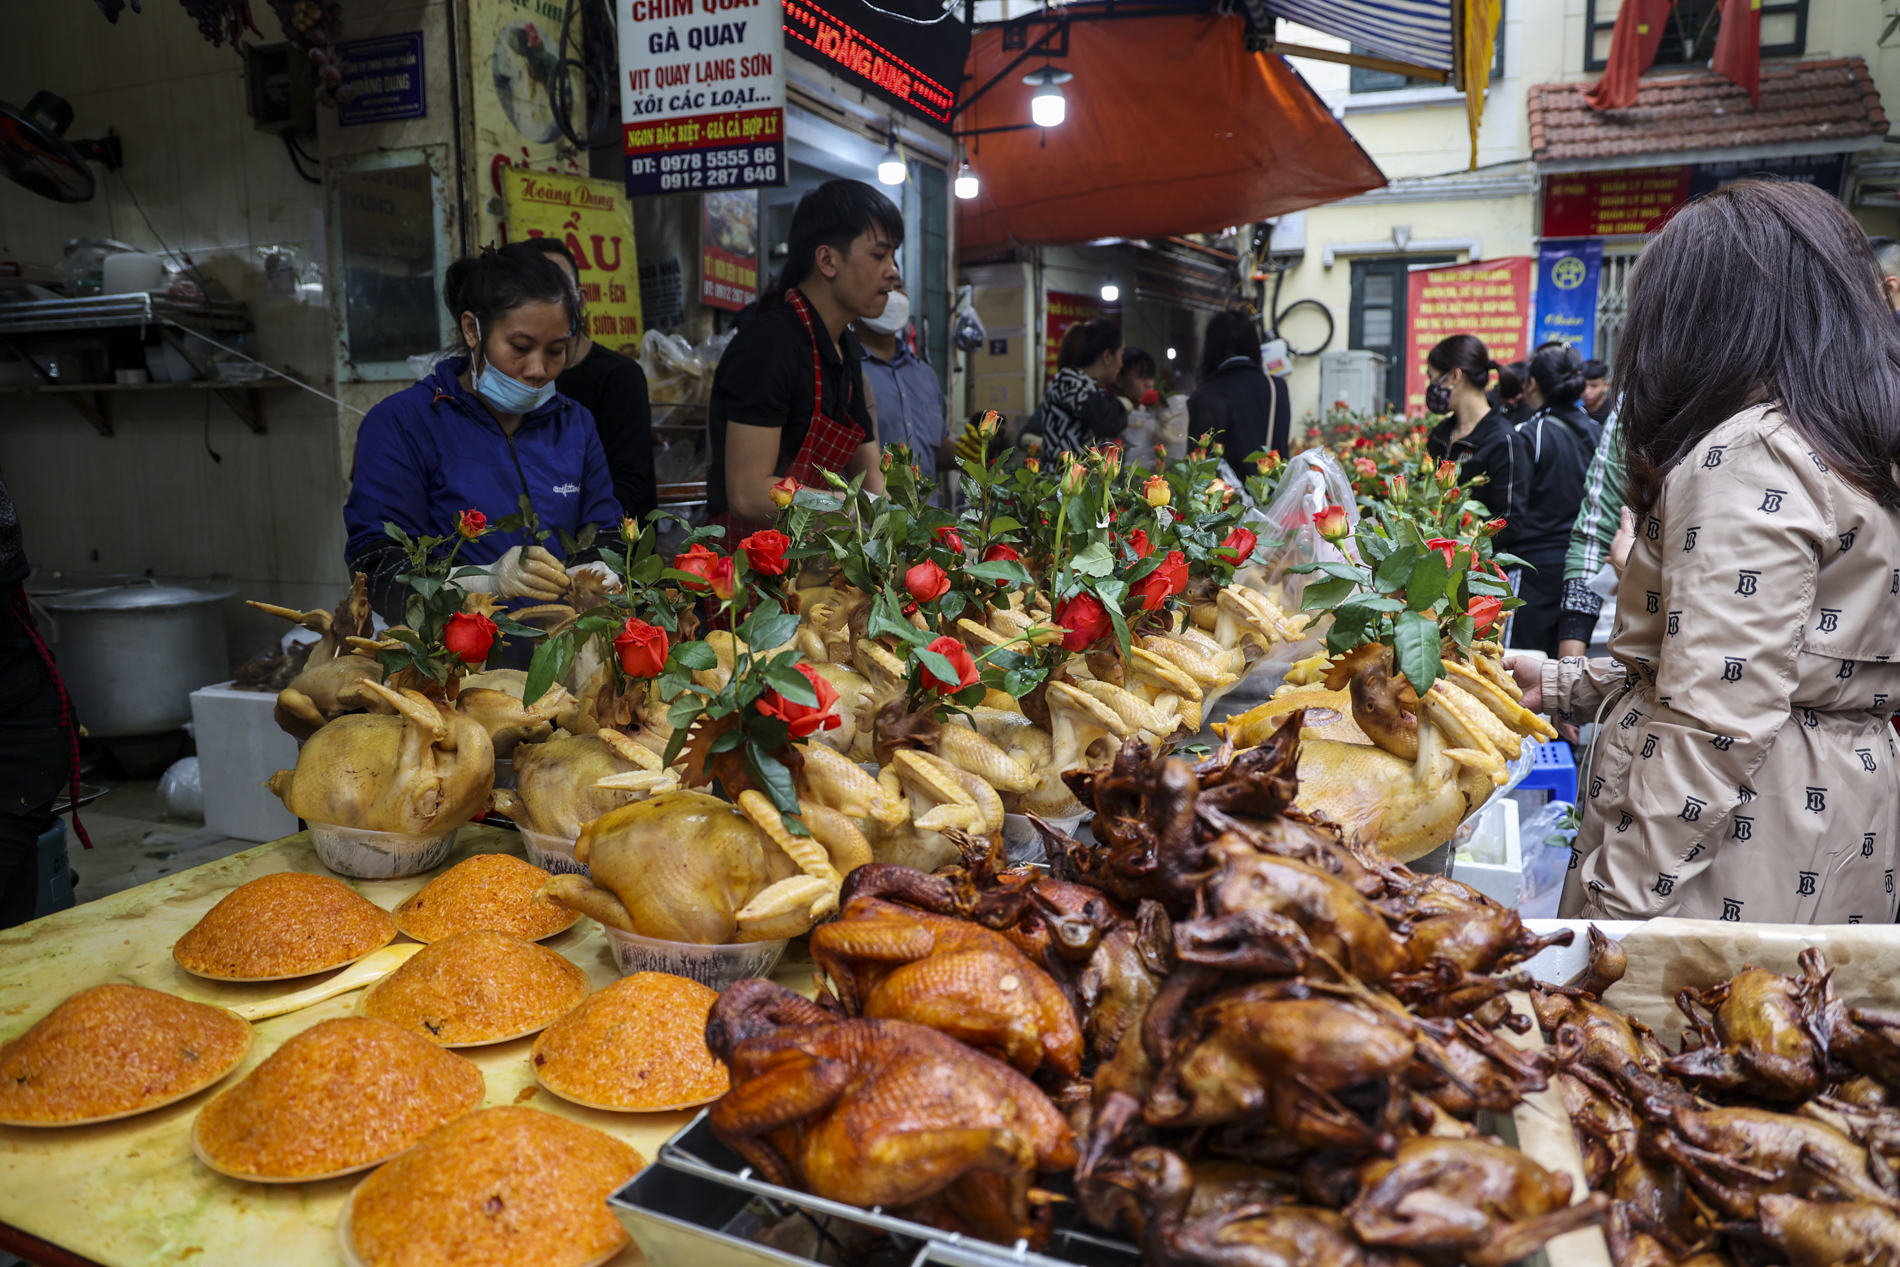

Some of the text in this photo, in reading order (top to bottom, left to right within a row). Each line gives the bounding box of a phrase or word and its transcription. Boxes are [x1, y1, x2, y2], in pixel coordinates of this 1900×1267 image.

[632, 0, 761, 22] CHIM QU
[649, 21, 747, 54] GÀ QUAY
[629, 53, 772, 95] VỊT QUAY LẠNG SƠN
[813, 21, 913, 102] HOÀNG DUNG
[383, 73, 411, 92] DUNG
[633, 87, 771, 115] XÔI CÁC LOẠI...
[628, 128, 655, 148] NGON
[655, 121, 677, 149] ĐẶC
[677, 118, 701, 147] BIỆT
[706, 115, 726, 140] GIÁ
[726, 113, 742, 137] CẢ
[742, 114, 763, 141] HỢP
[764, 110, 778, 134] LÝ
[631, 146, 776, 175] ĐT: 0978 5555 66
[660, 165, 777, 190] 0912 287 640
[520, 177, 615, 211] Hoàng Dung
[526, 210, 622, 272] ẨU
[578, 282, 602, 303] HIM
[608, 276, 627, 303] ẾCH
[593, 311, 618, 335] SƯỜN
[619, 315, 637, 339] SỤN
